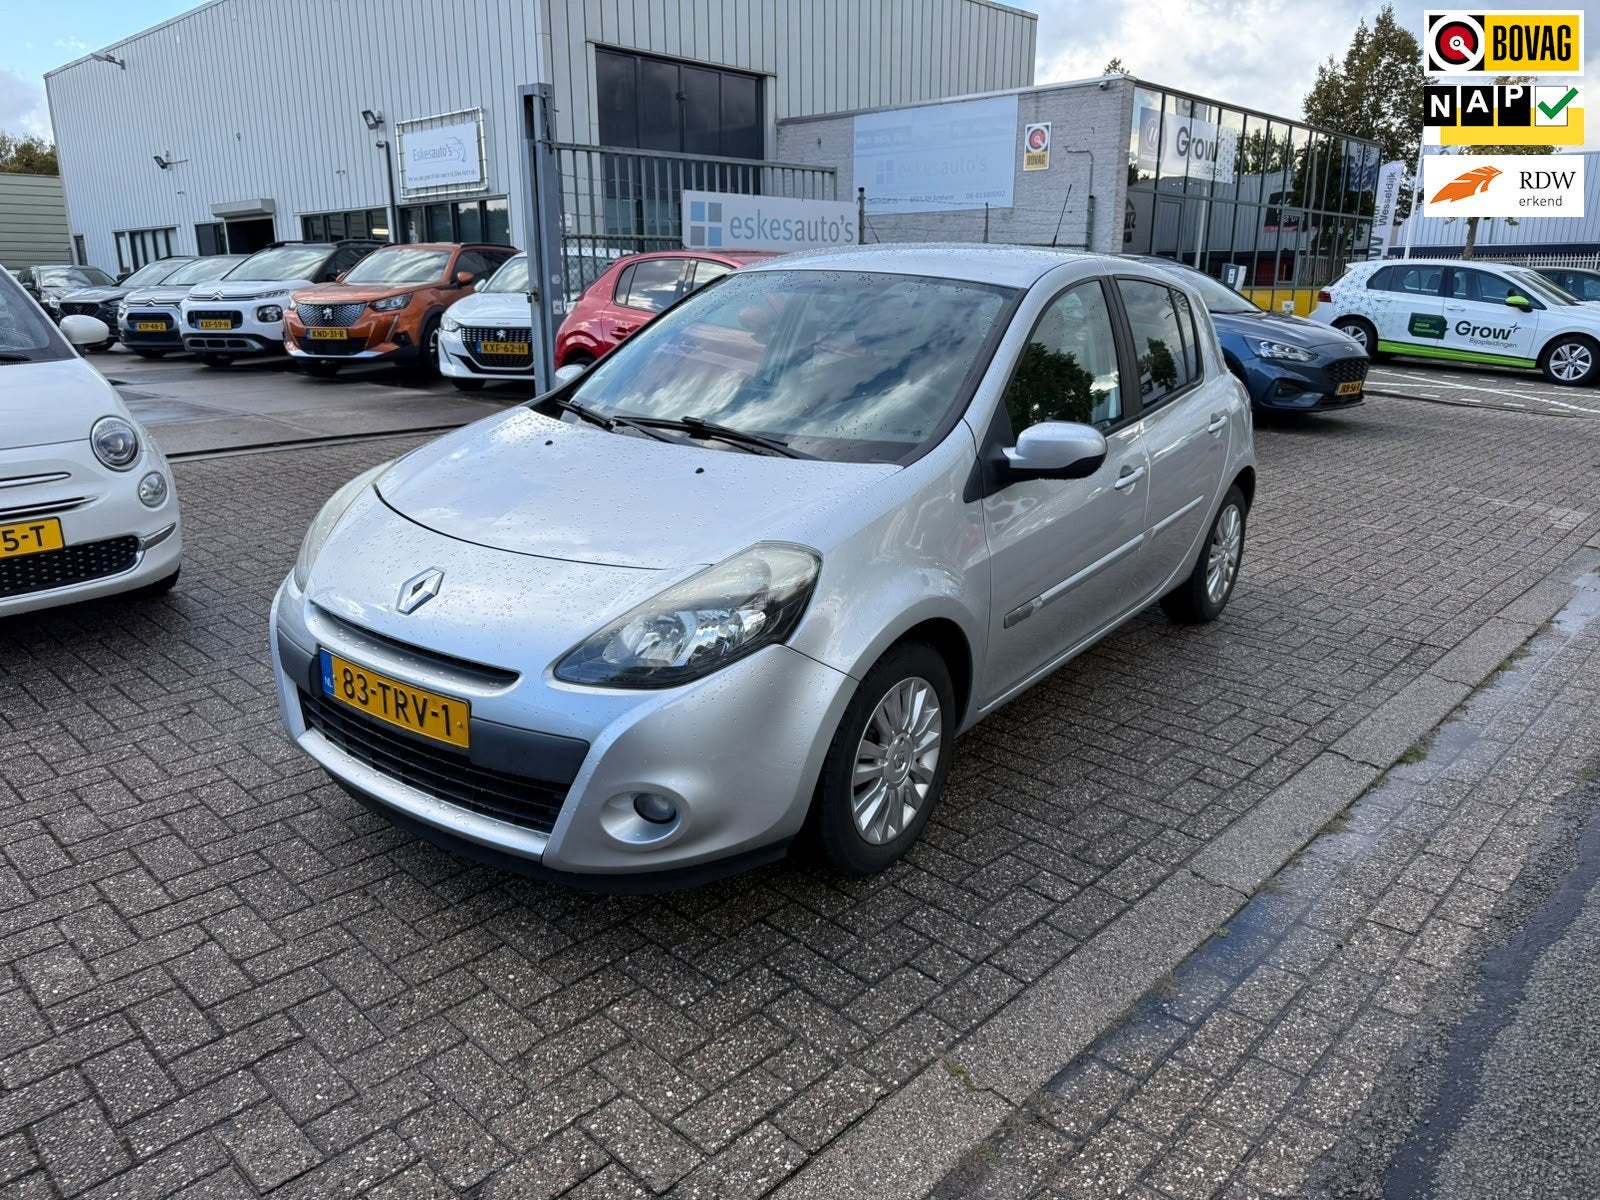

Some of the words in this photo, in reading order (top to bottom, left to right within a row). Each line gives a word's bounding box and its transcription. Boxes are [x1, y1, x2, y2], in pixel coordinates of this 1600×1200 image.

[1026, 154, 1045, 166] BOVAG
[1378, 172, 1397, 226] Wesseldijk
[730, 208, 854, 243] eskesauto's
[312, 330, 345, 338] KND-31-R
[1455, 320, 1512, 340] Grow
[483, 344, 525, 352] KXF-62-H
[1468, 338, 1518, 349] Rijopleidingen
[342, 667, 452, 737] 83-TRV-1
